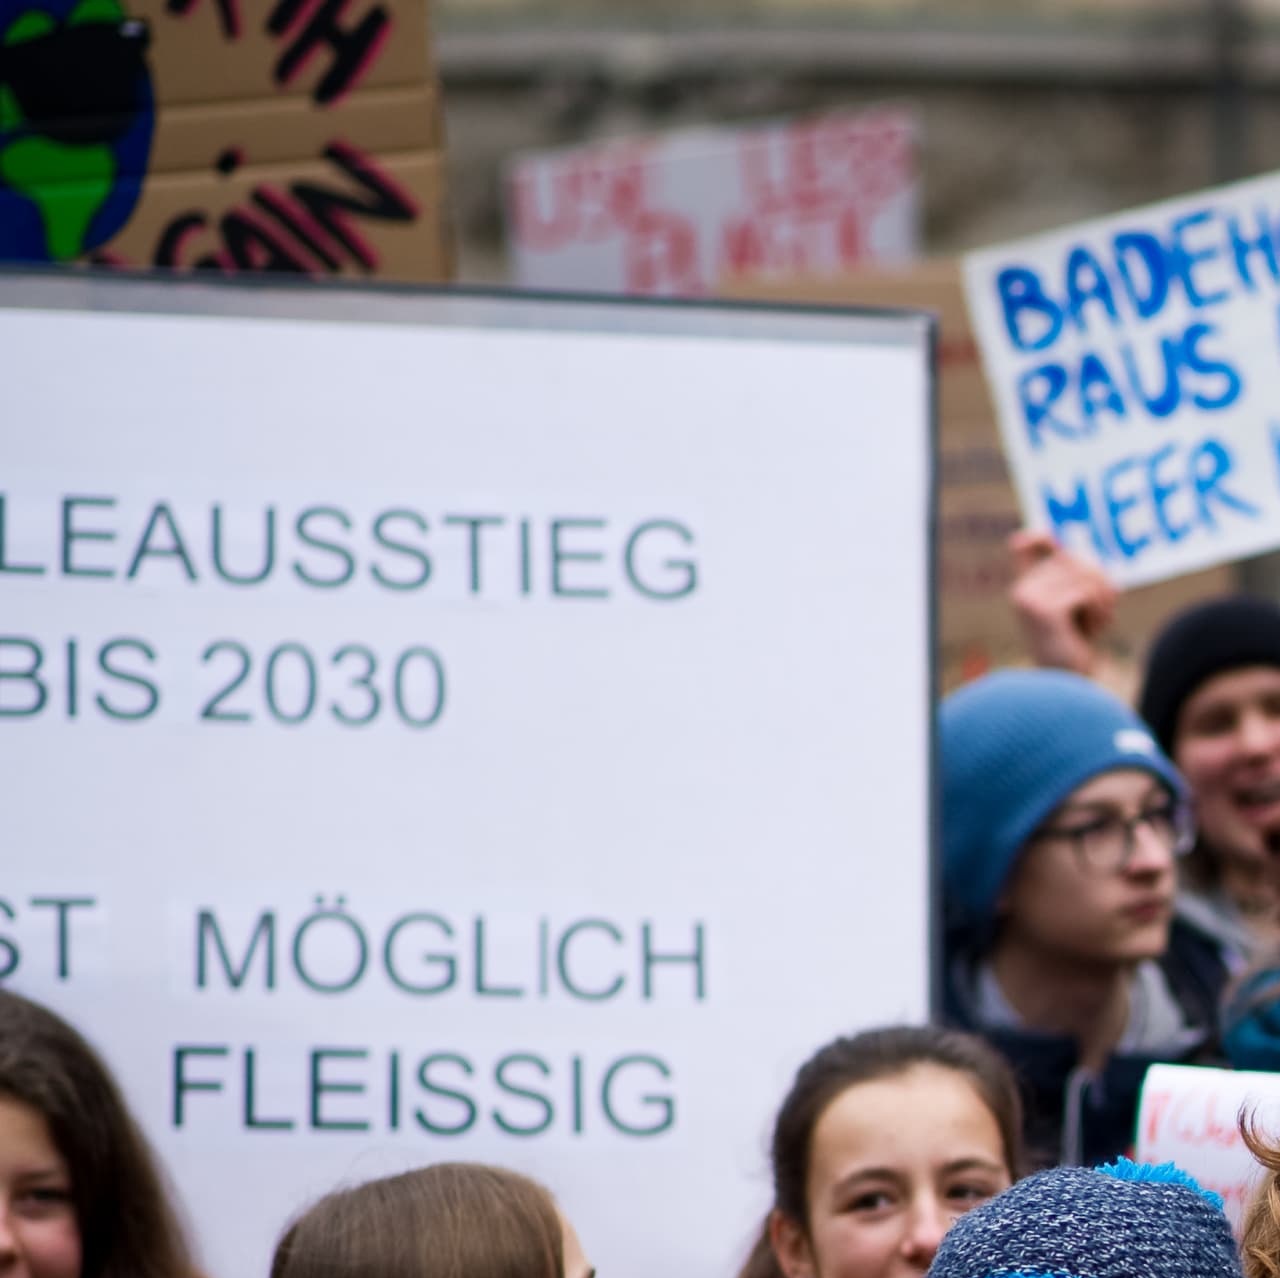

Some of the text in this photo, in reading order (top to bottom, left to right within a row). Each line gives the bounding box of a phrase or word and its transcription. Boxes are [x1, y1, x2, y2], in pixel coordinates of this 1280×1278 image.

[90, 140, 420, 278] GAIN
[1016, 320, 1244, 451] RAUS
[0, 491, 701, 601] LEAUSSTIEG
[1042, 439, 1262, 563] MEER
[0, 636, 449, 728] BIS 2030
[194, 893, 710, 1003] MÖGLICH
[172, 1044, 678, 1139] FLEISSIG
